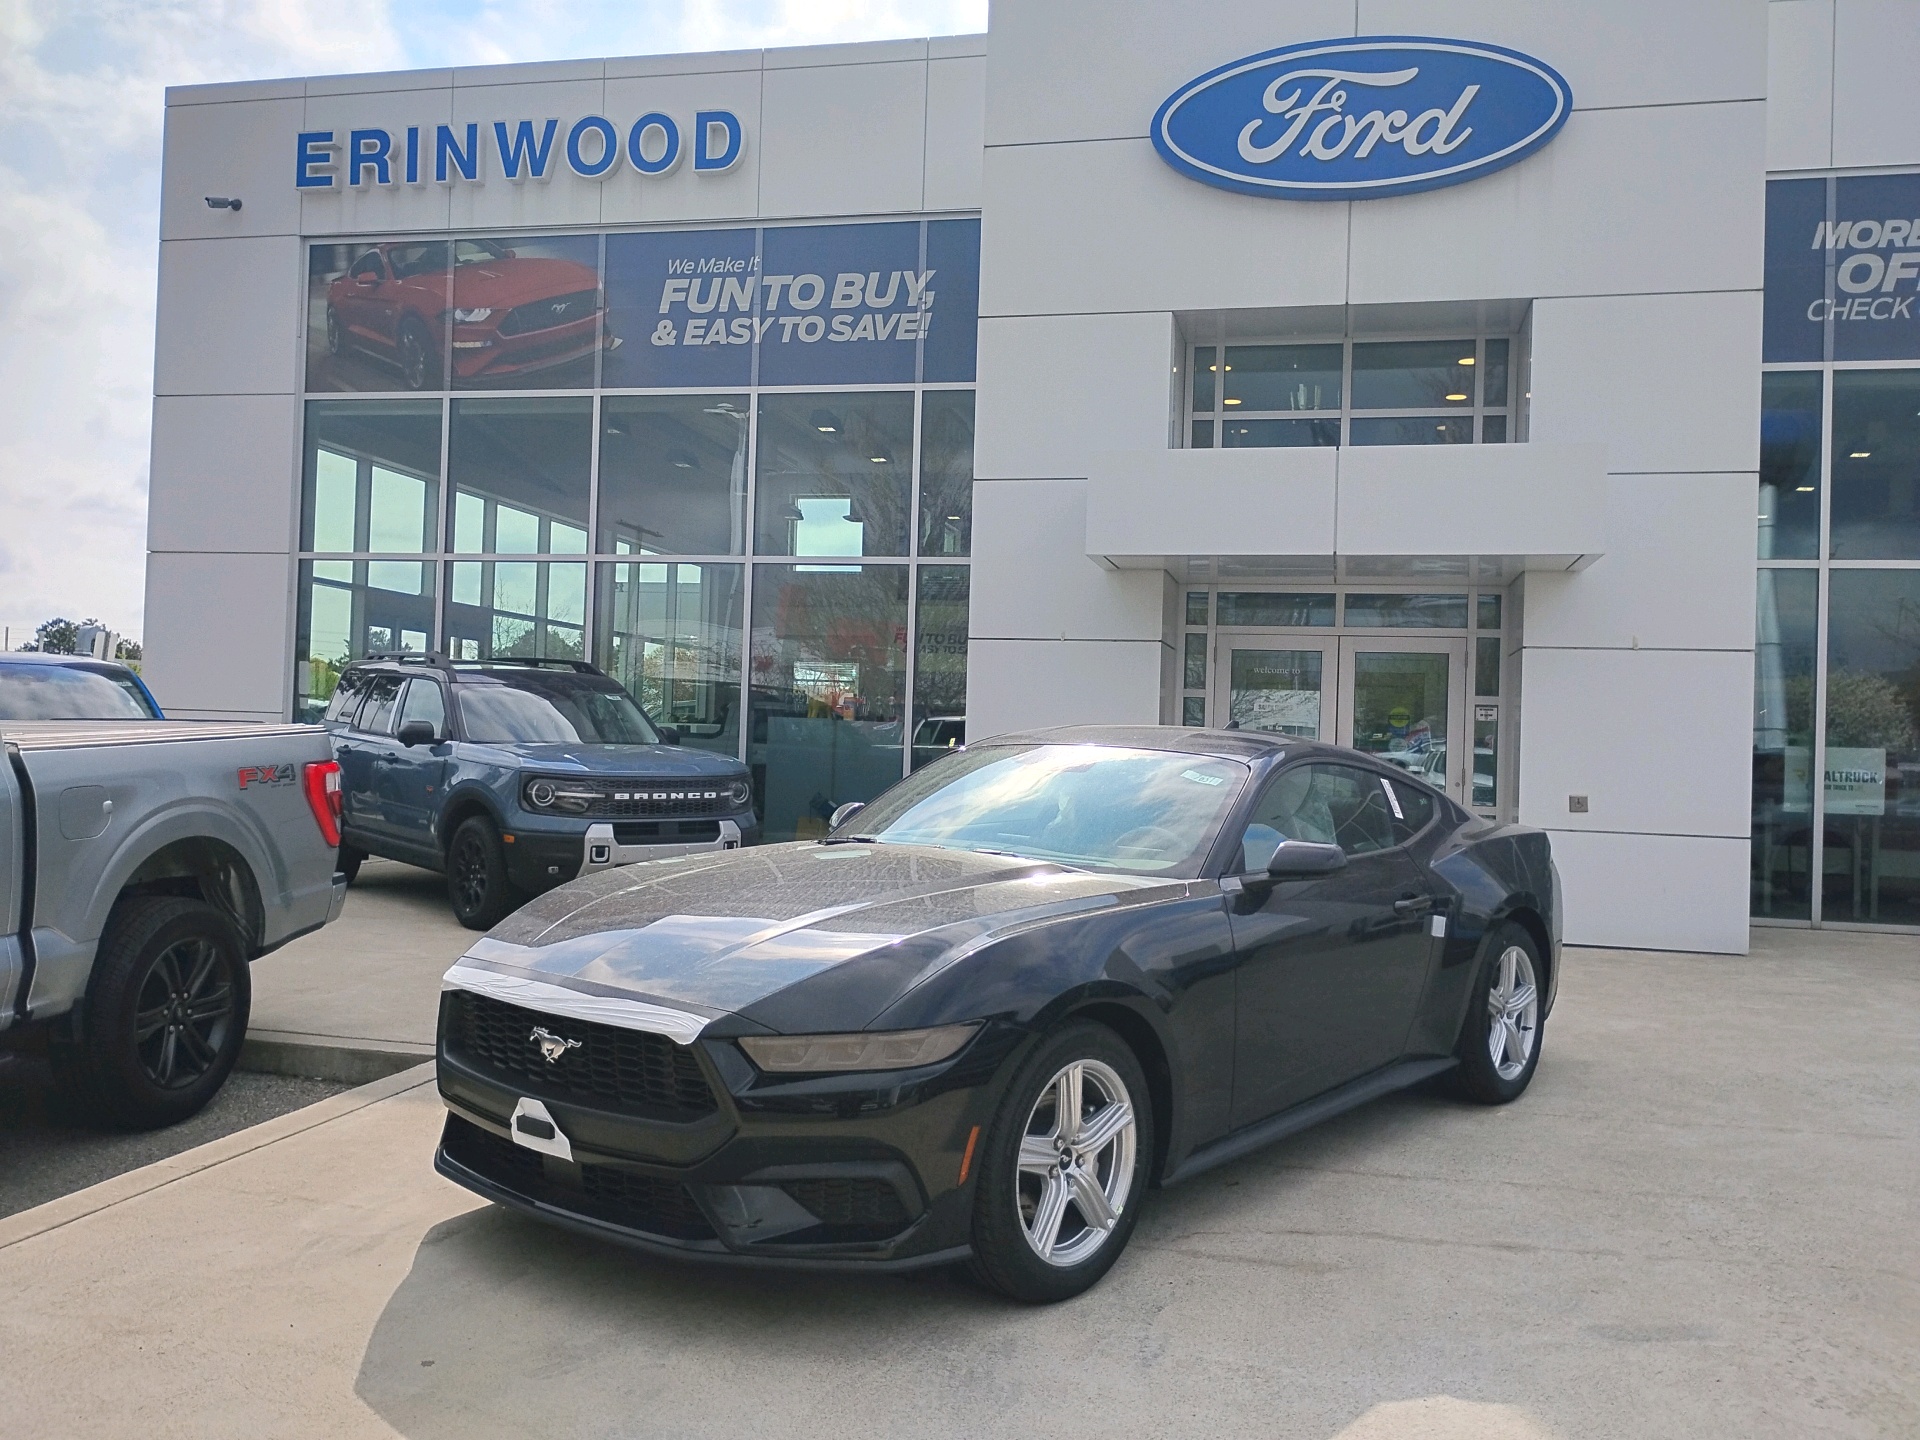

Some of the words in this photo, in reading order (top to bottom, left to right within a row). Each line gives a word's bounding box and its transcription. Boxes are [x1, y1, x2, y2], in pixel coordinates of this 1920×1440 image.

[1238, 67, 1480, 164] Ford
[295, 110, 743, 188] ERINWOOD
[668, 258, 694, 274] We
[697, 257, 744, 273] Make
[748, 255, 760, 271] It
[659, 276, 754, 313] FUN
[762, 274, 826, 311] TO
[831, 270, 936, 309] BUY,
[1807, 297, 1915, 321] CHECK
[651, 320, 677, 345] &
[683, 317, 775, 345] EASY
[779, 316, 826, 342] TO
[828, 312, 932, 342] SAVE!
[1254, 666, 1289, 674] welcome
[237, 763, 296, 790] FX4
[614, 792, 717, 800] BRONCO
